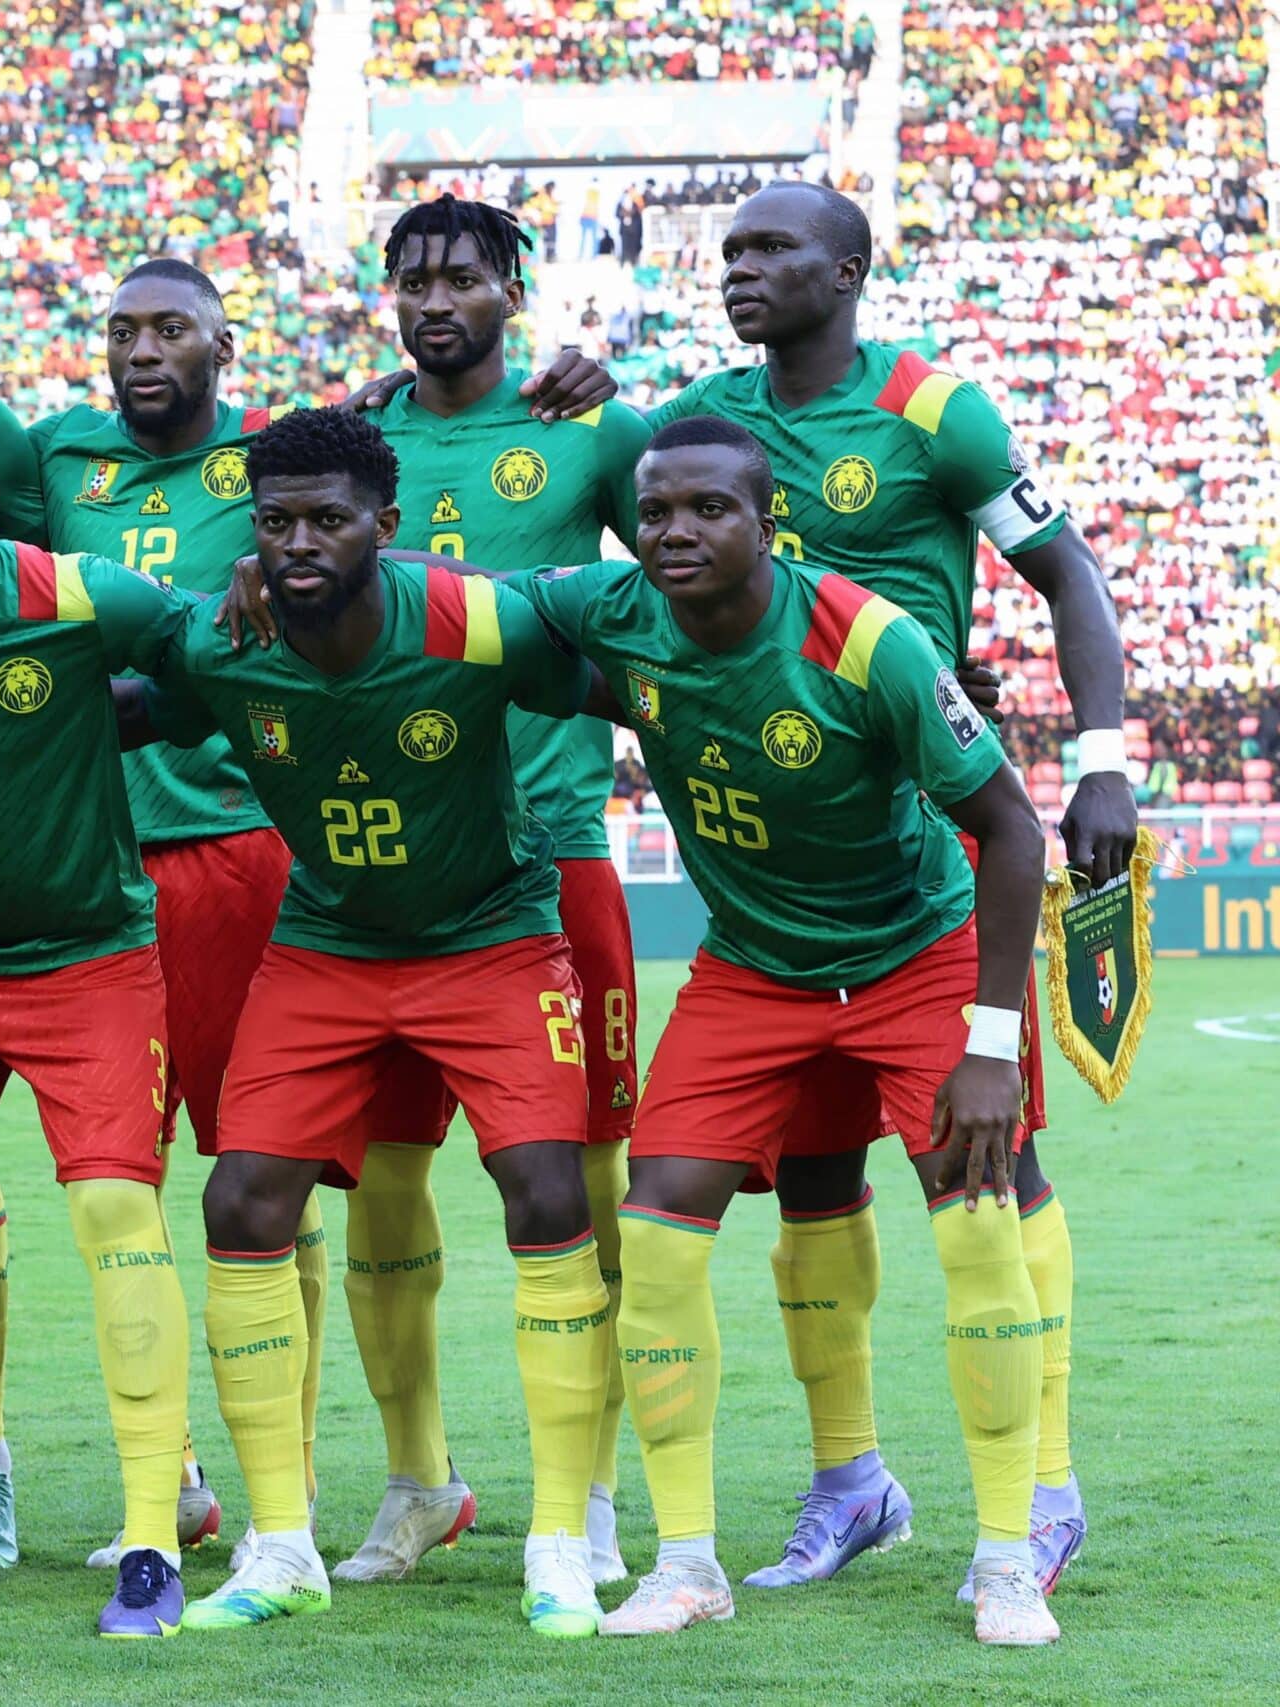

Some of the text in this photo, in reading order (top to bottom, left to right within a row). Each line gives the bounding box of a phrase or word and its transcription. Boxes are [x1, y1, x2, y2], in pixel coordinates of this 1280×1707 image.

[1011, 478, 1053, 524] C
[121, 527, 178, 584] 12
[687, 776, 769, 850] 25
[320, 798, 408, 866] 22
[604, 988, 628, 1062] 8
[150, 1037, 166, 1114] 3
[97, 1254, 112, 1270] LE
[115, 1251, 151, 1268] COQ
[378, 1246, 442, 1273] SPORTIF
[517, 1316, 529, 1330] LE
[530, 1319, 561, 1334] COQ
[947, 1323, 957, 1337] LE
[959, 1327, 988, 1338] COQ
[223, 1335, 293, 1359] SPORTIF
[625, 1348, 698, 1363] SPORTIF
